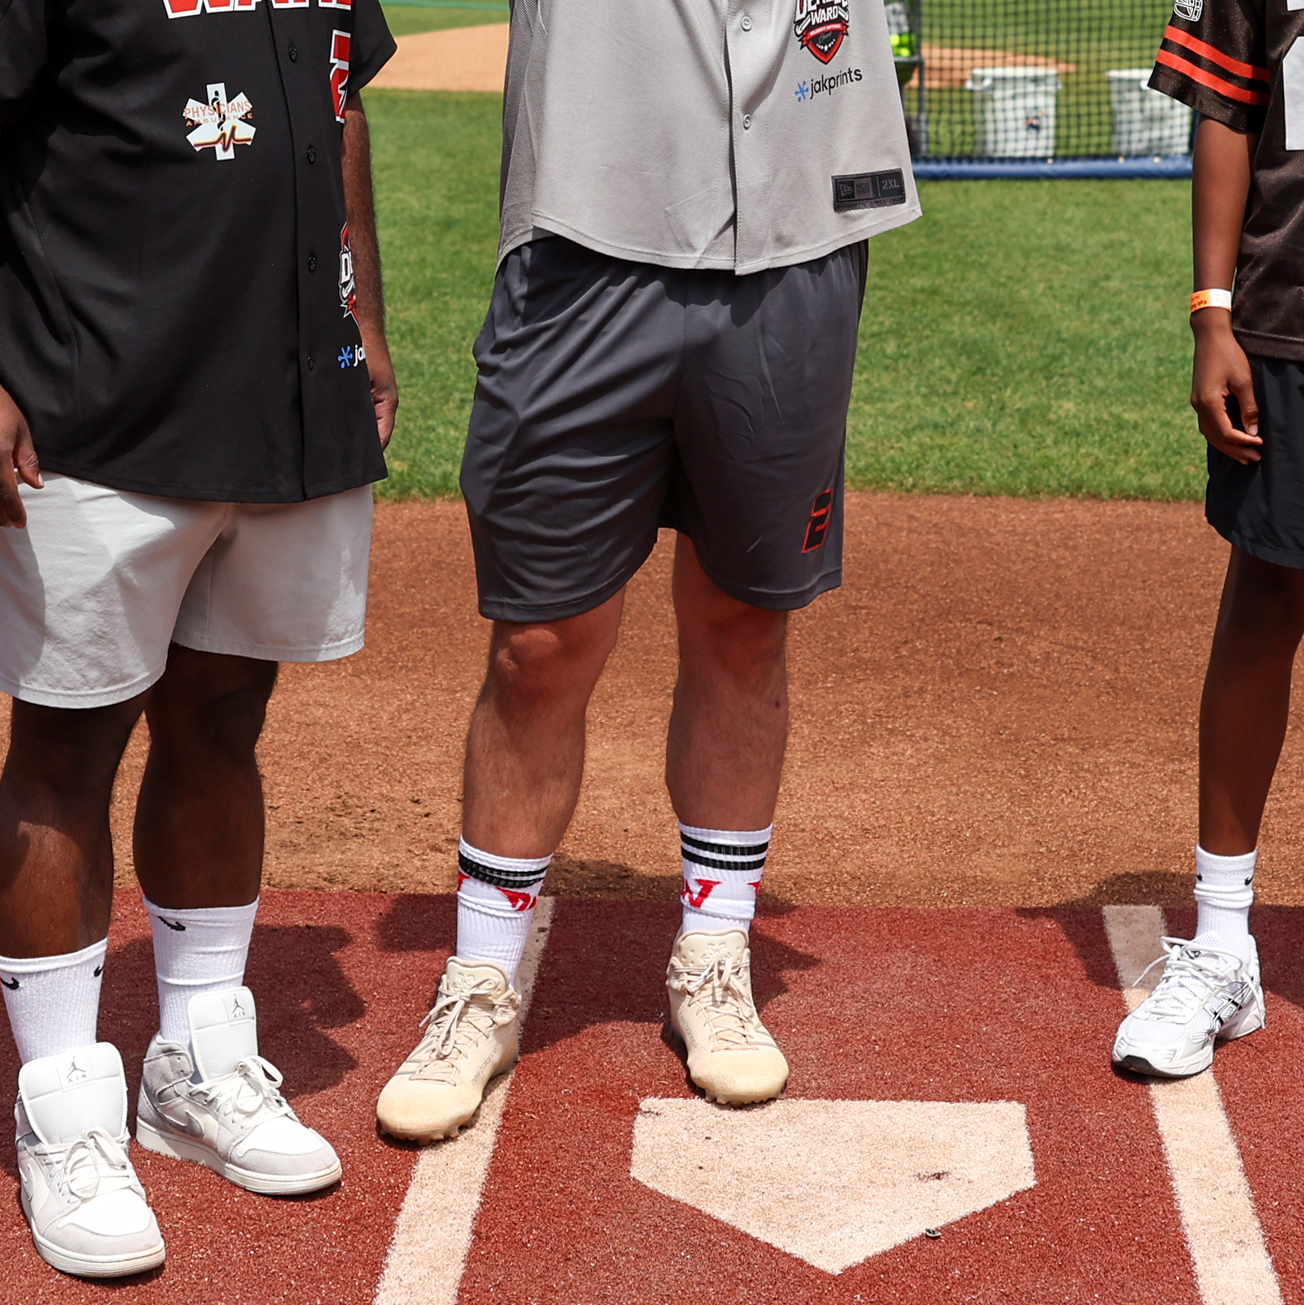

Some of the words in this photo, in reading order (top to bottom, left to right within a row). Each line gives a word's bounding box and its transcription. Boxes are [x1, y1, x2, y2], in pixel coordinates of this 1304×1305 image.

[810, 5, 840, 26] WARD
[809, 67, 864, 100] jakprints
[183, 99, 253, 120] PHYSICIANS
[185, 112, 254, 127] AMBULANCE
[881, 178, 900, 191] 2XL
